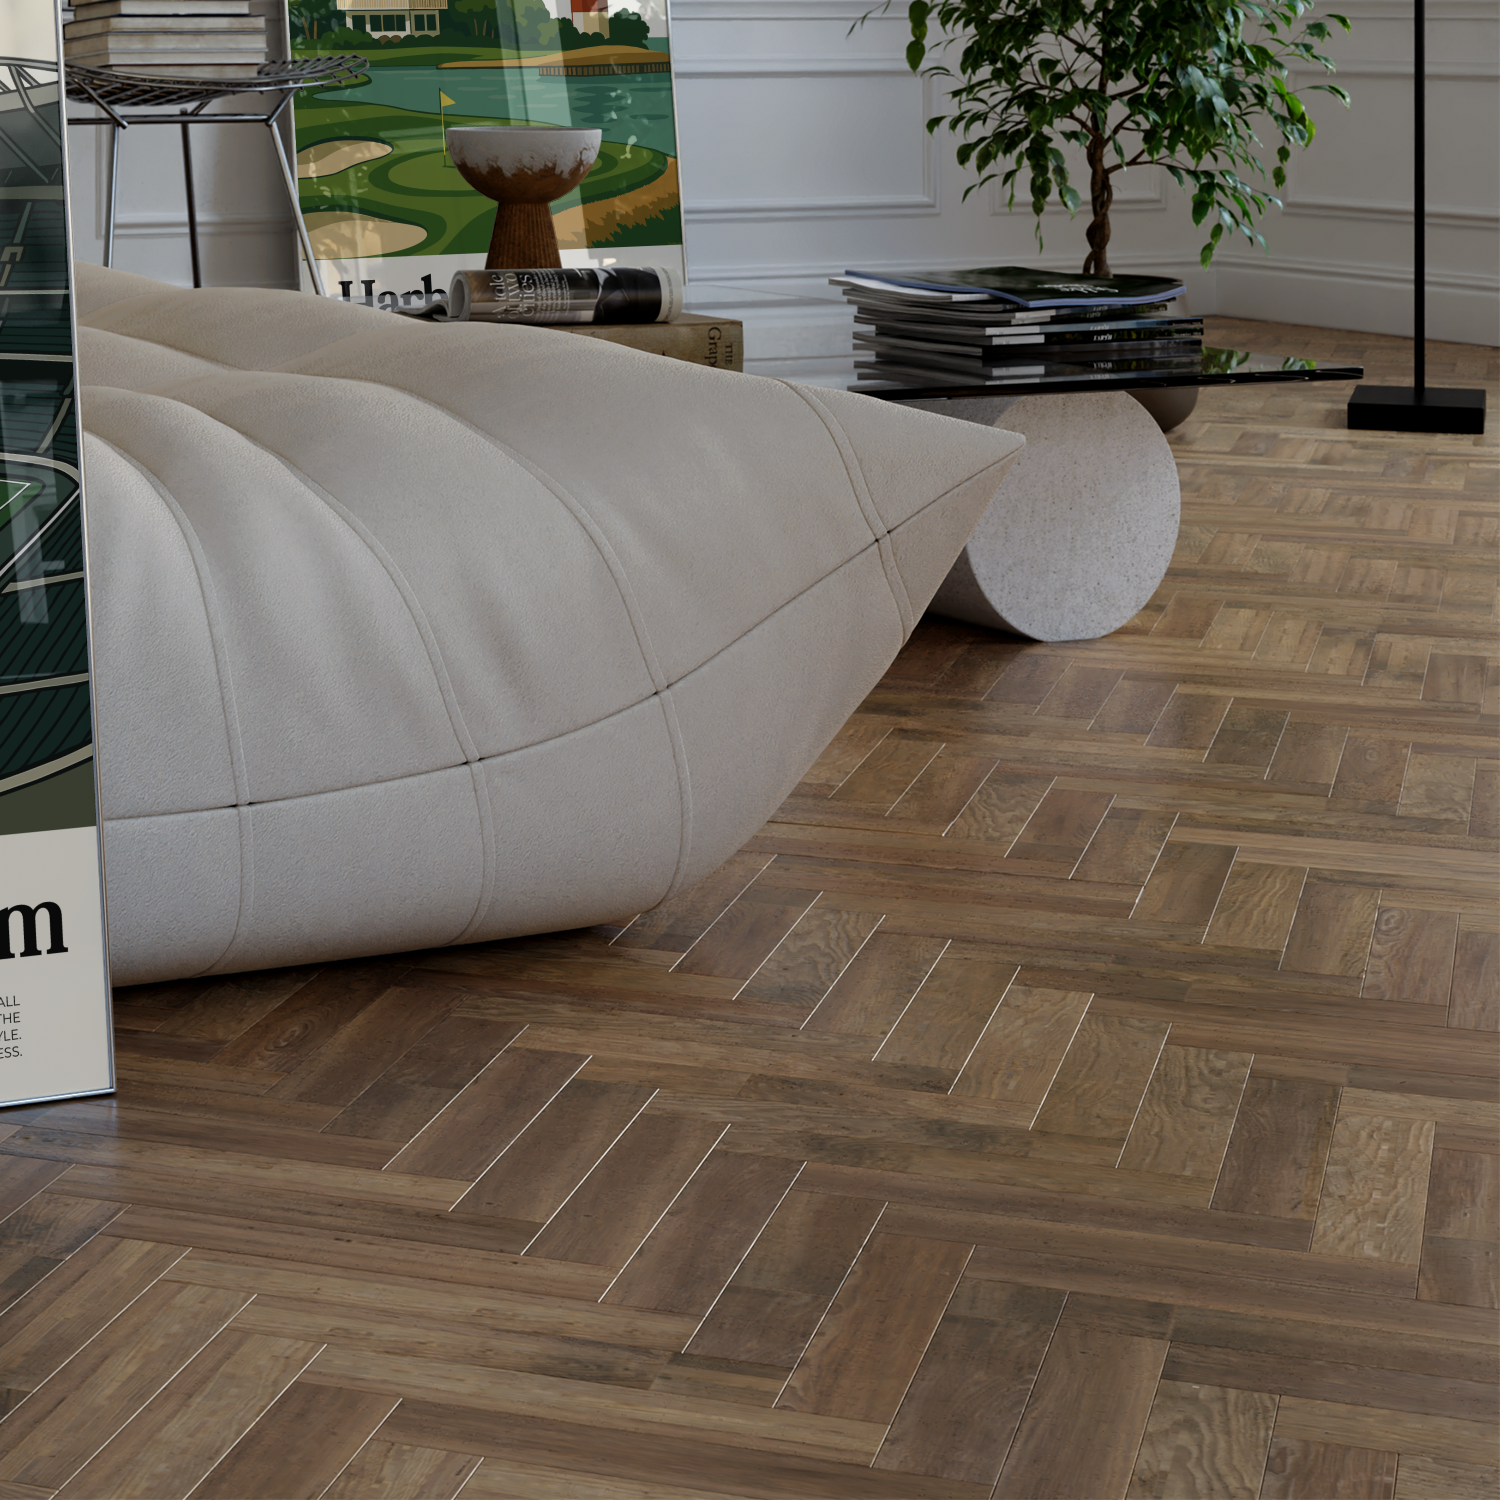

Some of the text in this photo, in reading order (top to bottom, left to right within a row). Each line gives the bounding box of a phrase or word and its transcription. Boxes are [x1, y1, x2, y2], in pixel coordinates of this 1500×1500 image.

[488, 274, 507, 302] tale
[504, 272, 522, 302] two
[518, 273, 536, 318] cities
[704, 326, 722, 368] Grap
[724, 342, 734, 366] THE
